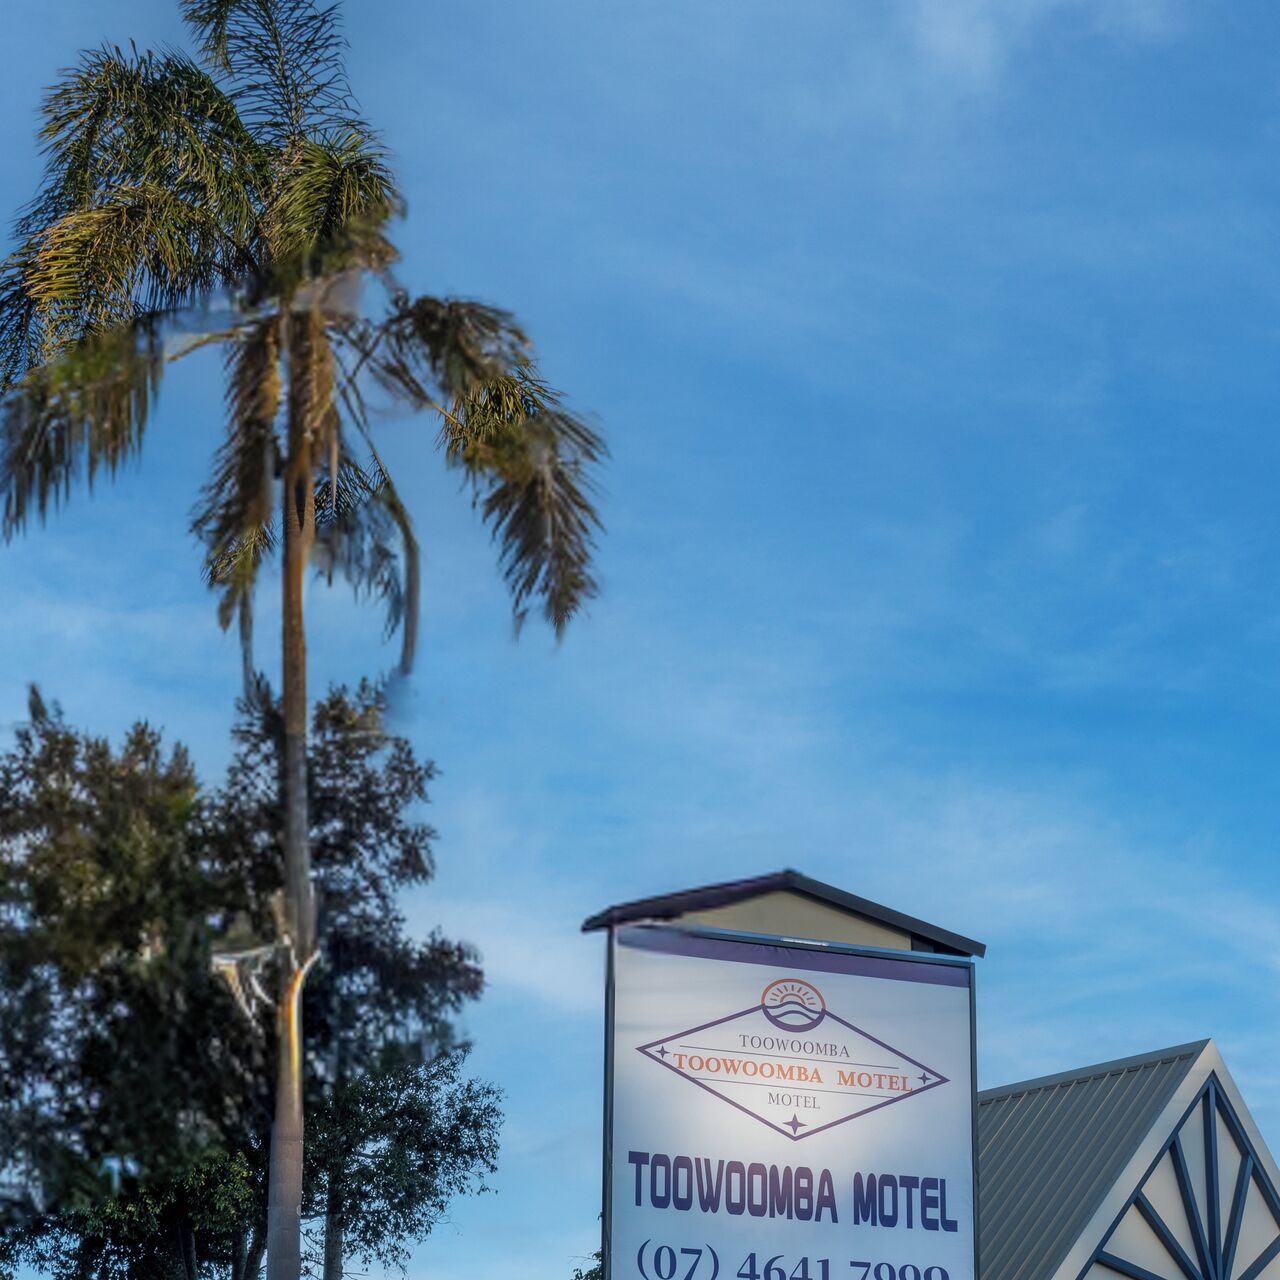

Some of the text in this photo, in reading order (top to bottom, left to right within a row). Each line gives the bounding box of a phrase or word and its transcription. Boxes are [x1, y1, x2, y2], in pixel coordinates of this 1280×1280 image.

[739, 1034, 851, 1058] TOOWOOMBA
[673, 1053, 914, 1092] TOOWOOMBA MOTEL
[767, 1092, 821, 1110] MOTEL
[628, 1151, 959, 1233] TOOWOOMBA MOTEL
